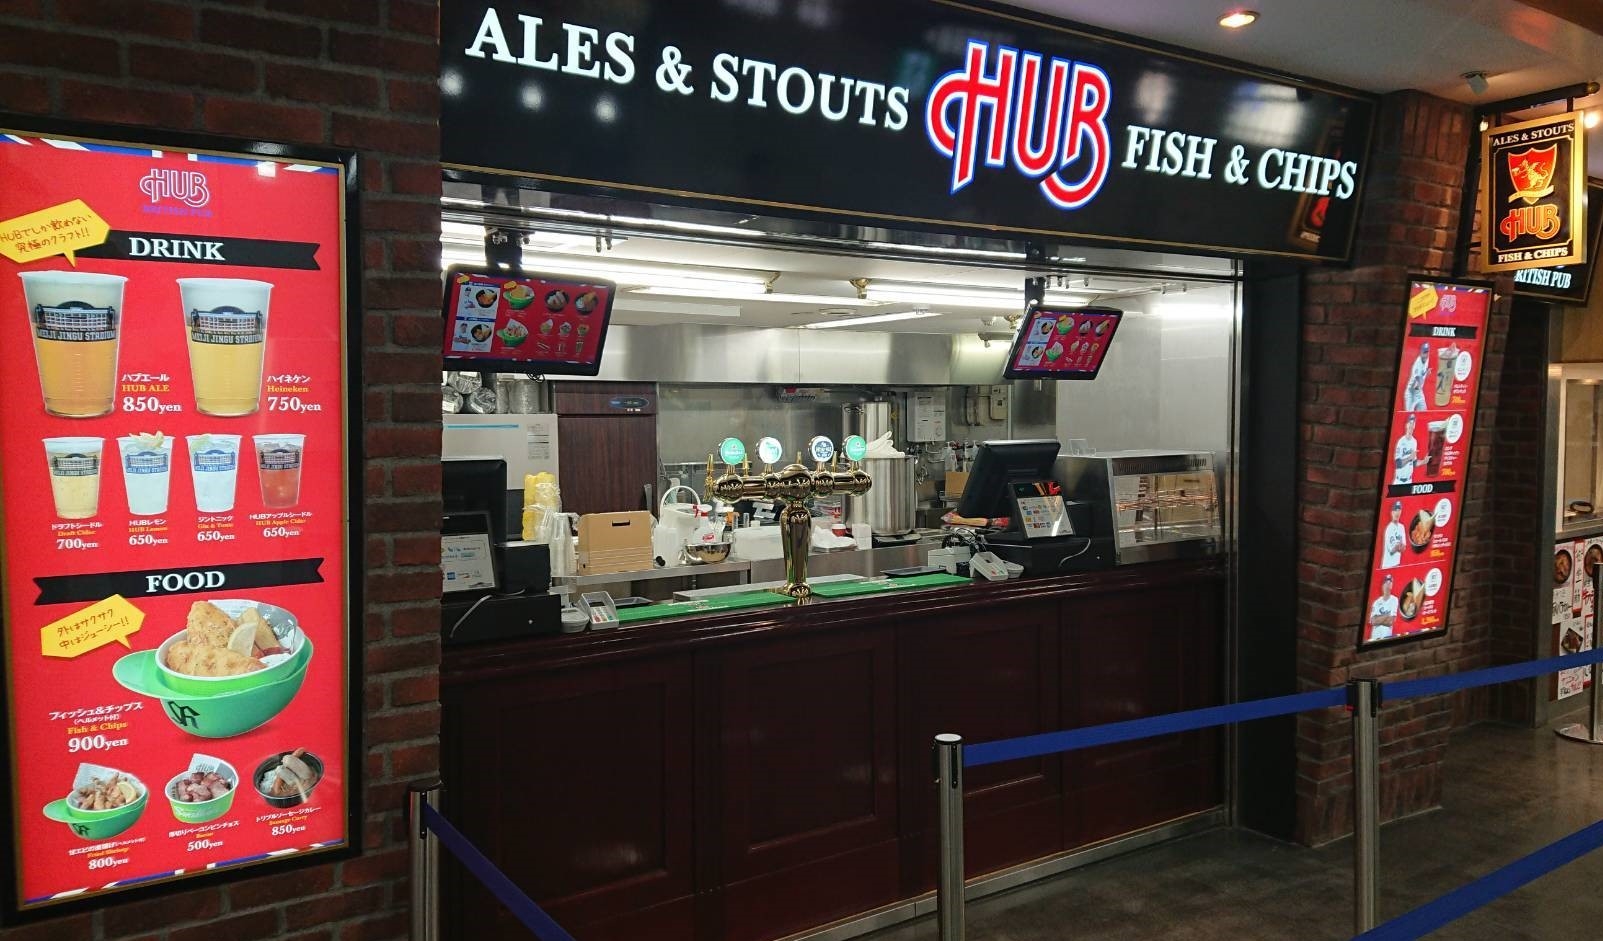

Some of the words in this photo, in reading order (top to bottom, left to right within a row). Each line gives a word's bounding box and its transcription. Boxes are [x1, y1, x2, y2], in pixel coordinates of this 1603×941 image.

[464, 7, 635, 85] ALES
[655, 45, 694, 95] &
[710, 52, 910, 131] STOUTS
[926, 38, 1112, 210] HUB
[1492, 133, 1519, 147] ALES
[1521, 132, 1530, 142] &
[1531, 122, 1574, 140] STOUTS
[1122, 124, 1217, 180] FISH
[1225, 144, 1249, 185] &
[1257, 148, 1357, 199] CHIPS
[140, 168, 210, 207] HUB
[1500, 203, 1560, 243] HUB
[129, 237, 225, 261] DRINK
[1498, 252, 1522, 263] FISH
[1524, 252, 1532, 261] &
[1534, 246, 1568, 259] CHIPS
[1551, 272, 1572, 289] PUB
[57, 330, 84, 341] JINGU
[210, 333, 234, 344] JINGU
[1432, 326, 1456, 337] DRINK
[122, 372, 170, 383] ハブエール
[267, 373, 311, 384] ハイネケン
[122, 384, 147, 392] HUB
[149, 384, 170, 393] ALE
[267, 384, 309, 393] Heineken
[123, 396, 182, 413] 850yen
[267, 396, 322, 413] 750yen
[1412, 483, 1433, 495] FOOD
[197, 531, 235, 542] 650yen
[263, 526, 300, 538] 650yen
[56, 538, 99, 550] 700yen
[128, 534, 168, 546] 650yen
[145, 570, 225, 592] FOOD
[57, 608, 114, 638] 外はサクサク
[67, 725, 88, 736] Fish
[90, 724, 98, 733] &
[100, 722, 128, 734] Chips
[68, 734, 129, 753] 900yen
[271, 824, 306, 836] 850yen
[187, 839, 224, 852] 500yen
[88, 856, 129, 870] 800yen
